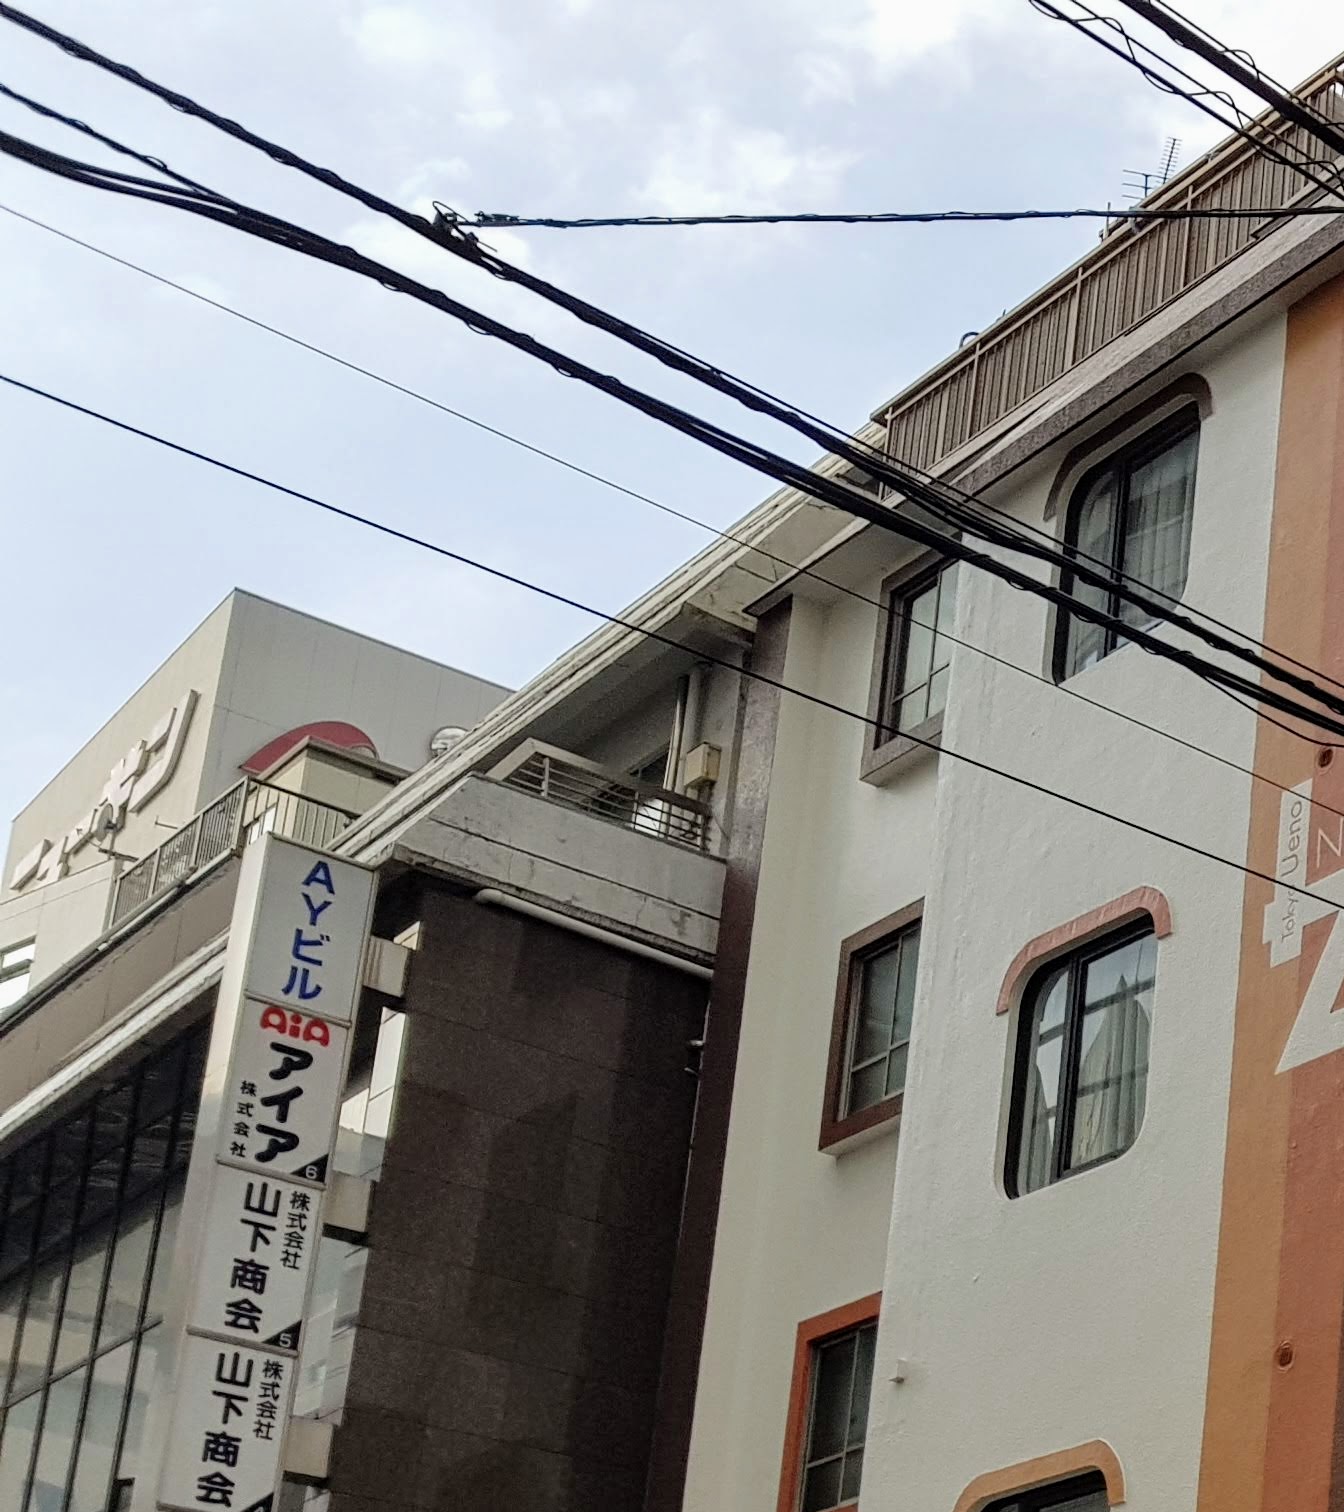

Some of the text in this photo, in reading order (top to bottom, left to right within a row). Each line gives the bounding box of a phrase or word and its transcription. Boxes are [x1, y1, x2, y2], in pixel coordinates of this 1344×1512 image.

[1281, 800, 1302, 878] Ueno
[282, 859, 334, 1000] AYビル
[229, 1080, 257, 1159] 株式会社
[255, 1041, 313, 1163] アイア
[305, 1164, 318, 1179] 6
[224, 1182, 281, 1334] 山下商会
[281, 1190, 310, 1270] 株式会社
[279, 1332, 292, 1349] 5
[195, 1352, 254, 1507] 山下商会
[252, 1359, 284, 1441] 株式会社
